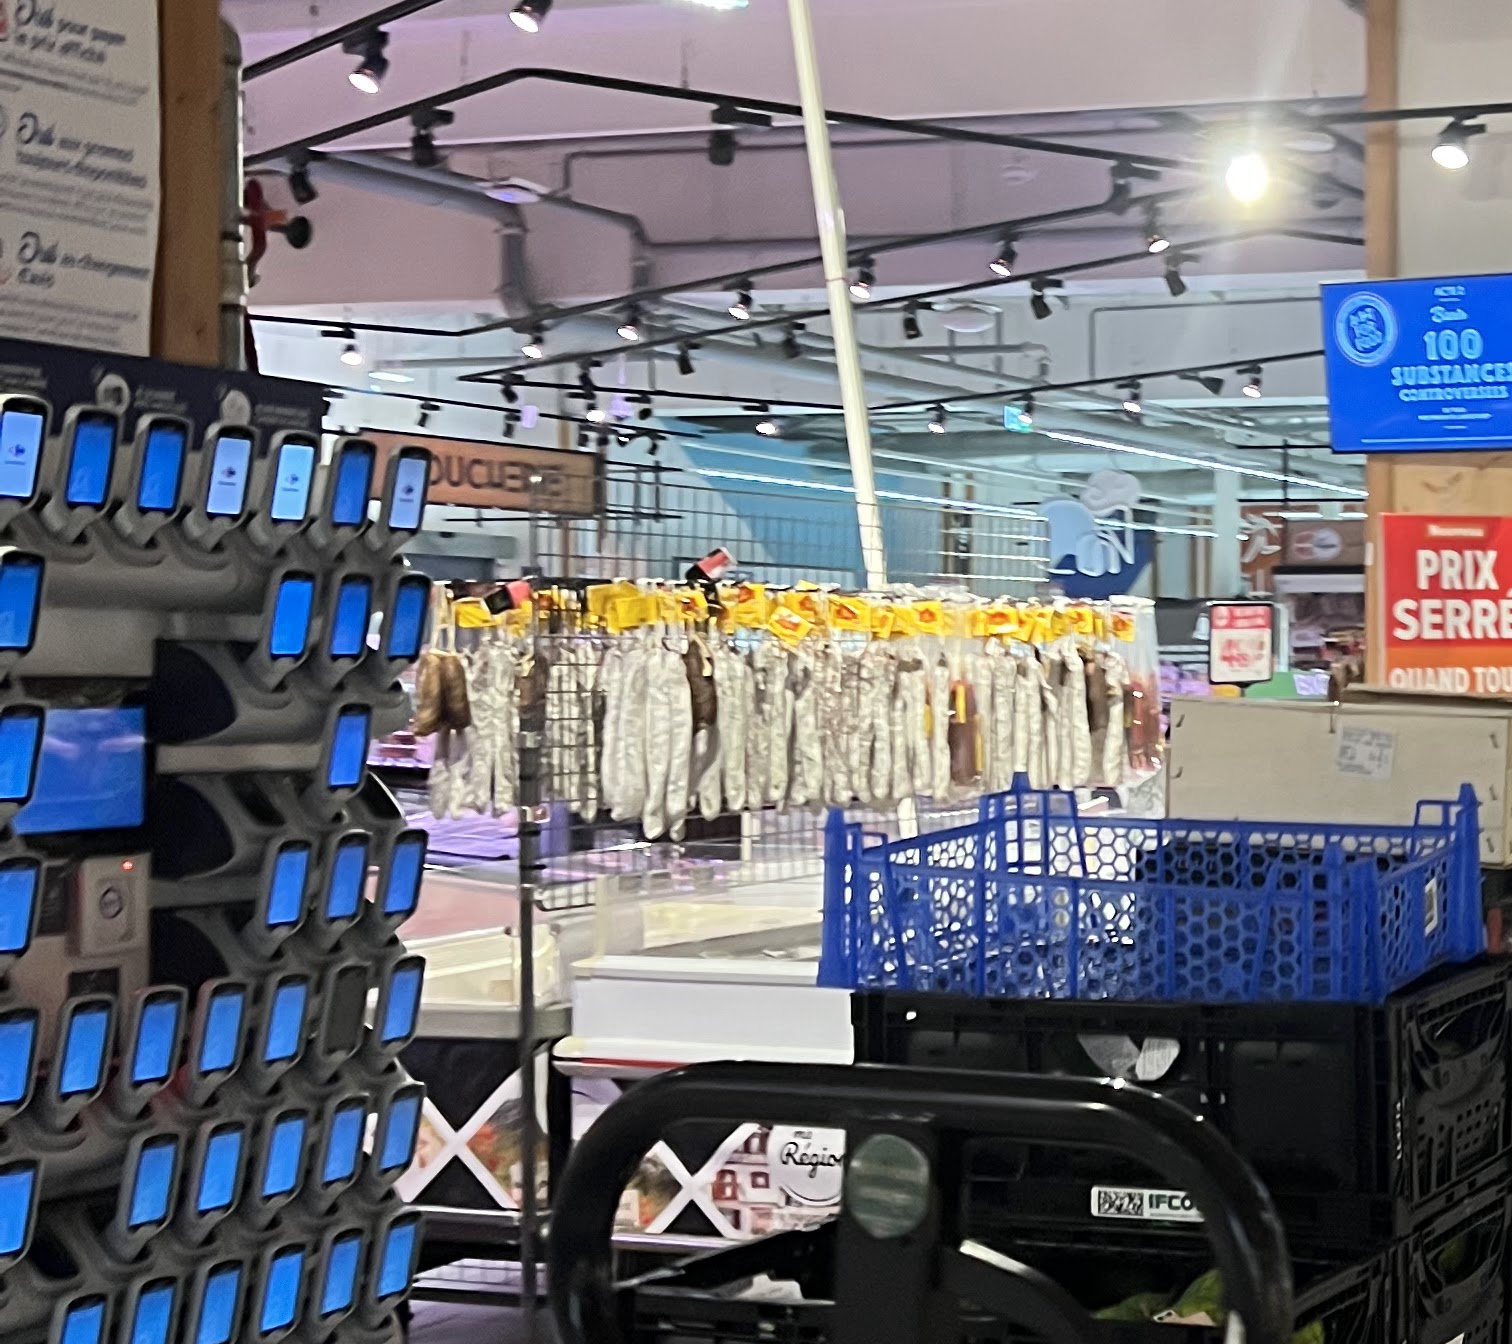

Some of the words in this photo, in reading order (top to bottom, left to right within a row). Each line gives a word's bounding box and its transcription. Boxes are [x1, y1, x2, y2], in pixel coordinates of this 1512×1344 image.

[1423, 329, 1484, 360] 100
[1416, 549, 1500, 590] PRIX
[1390, 667, 1470, 693] QUAND
[781, 1141, 843, 1179] Régio
[1149, 1193, 1193, 1211] IFCO
